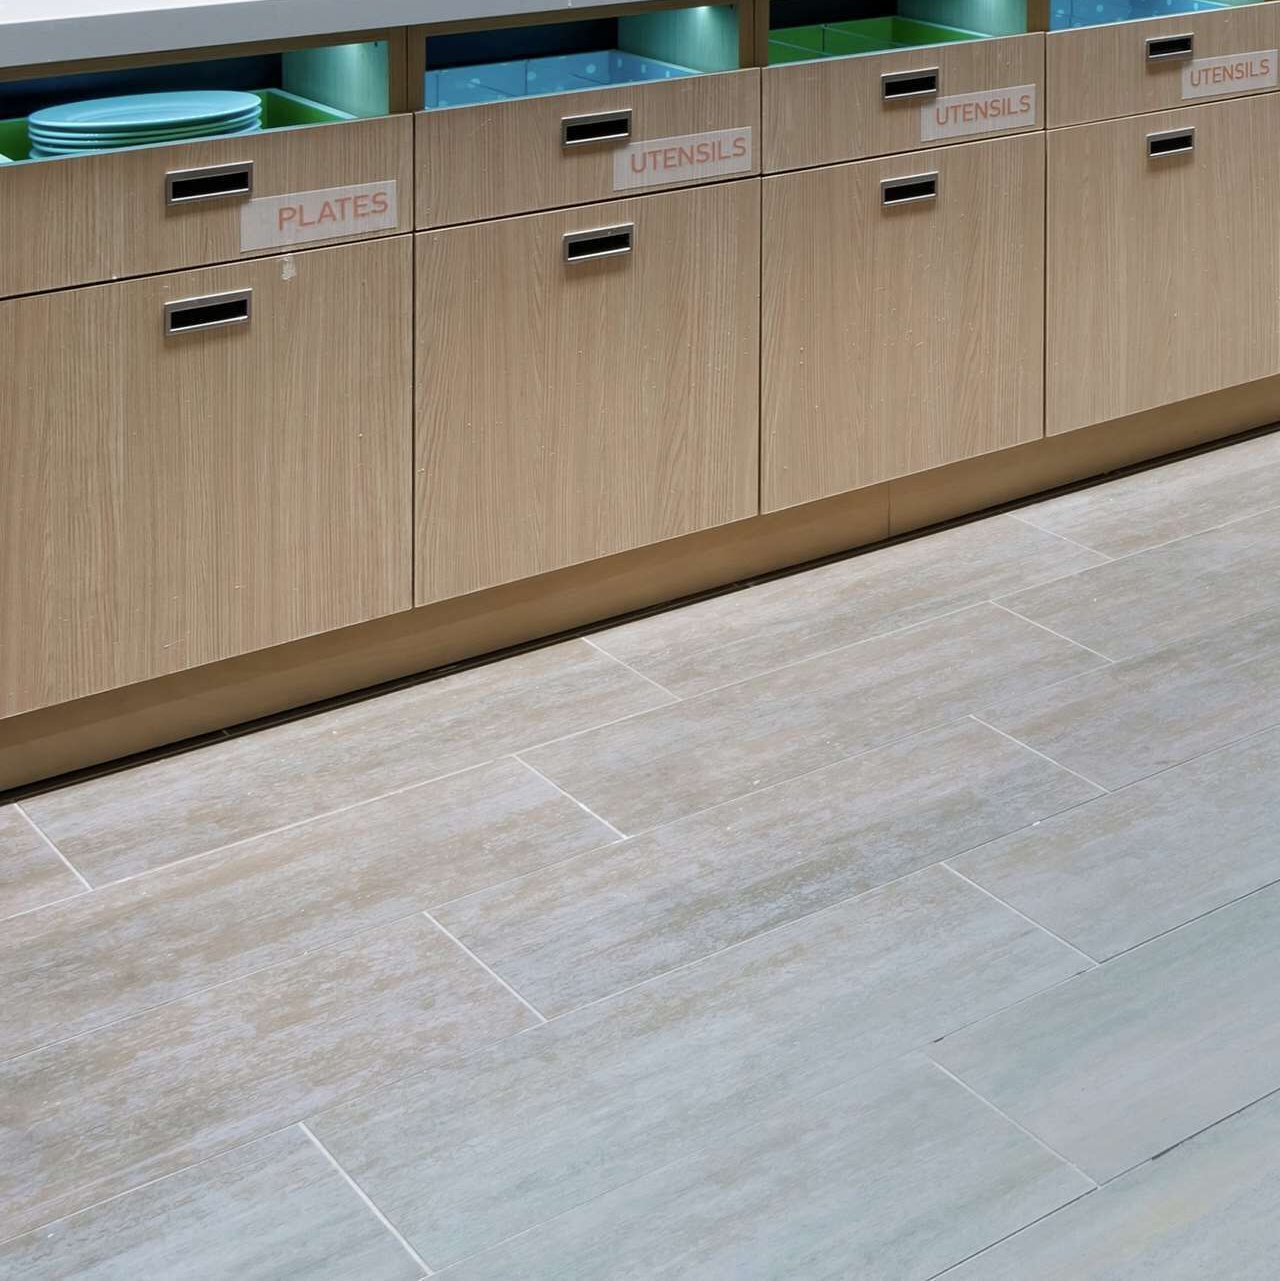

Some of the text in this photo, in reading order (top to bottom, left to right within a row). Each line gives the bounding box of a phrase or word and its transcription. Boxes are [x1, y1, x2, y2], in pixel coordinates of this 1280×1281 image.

[1189, 58, 1270, 88] UTENSILS
[935, 93, 1031, 127] UTENSILS
[630, 137, 747, 174] UTENSILS
[277, 191, 389, 232] PLATES
